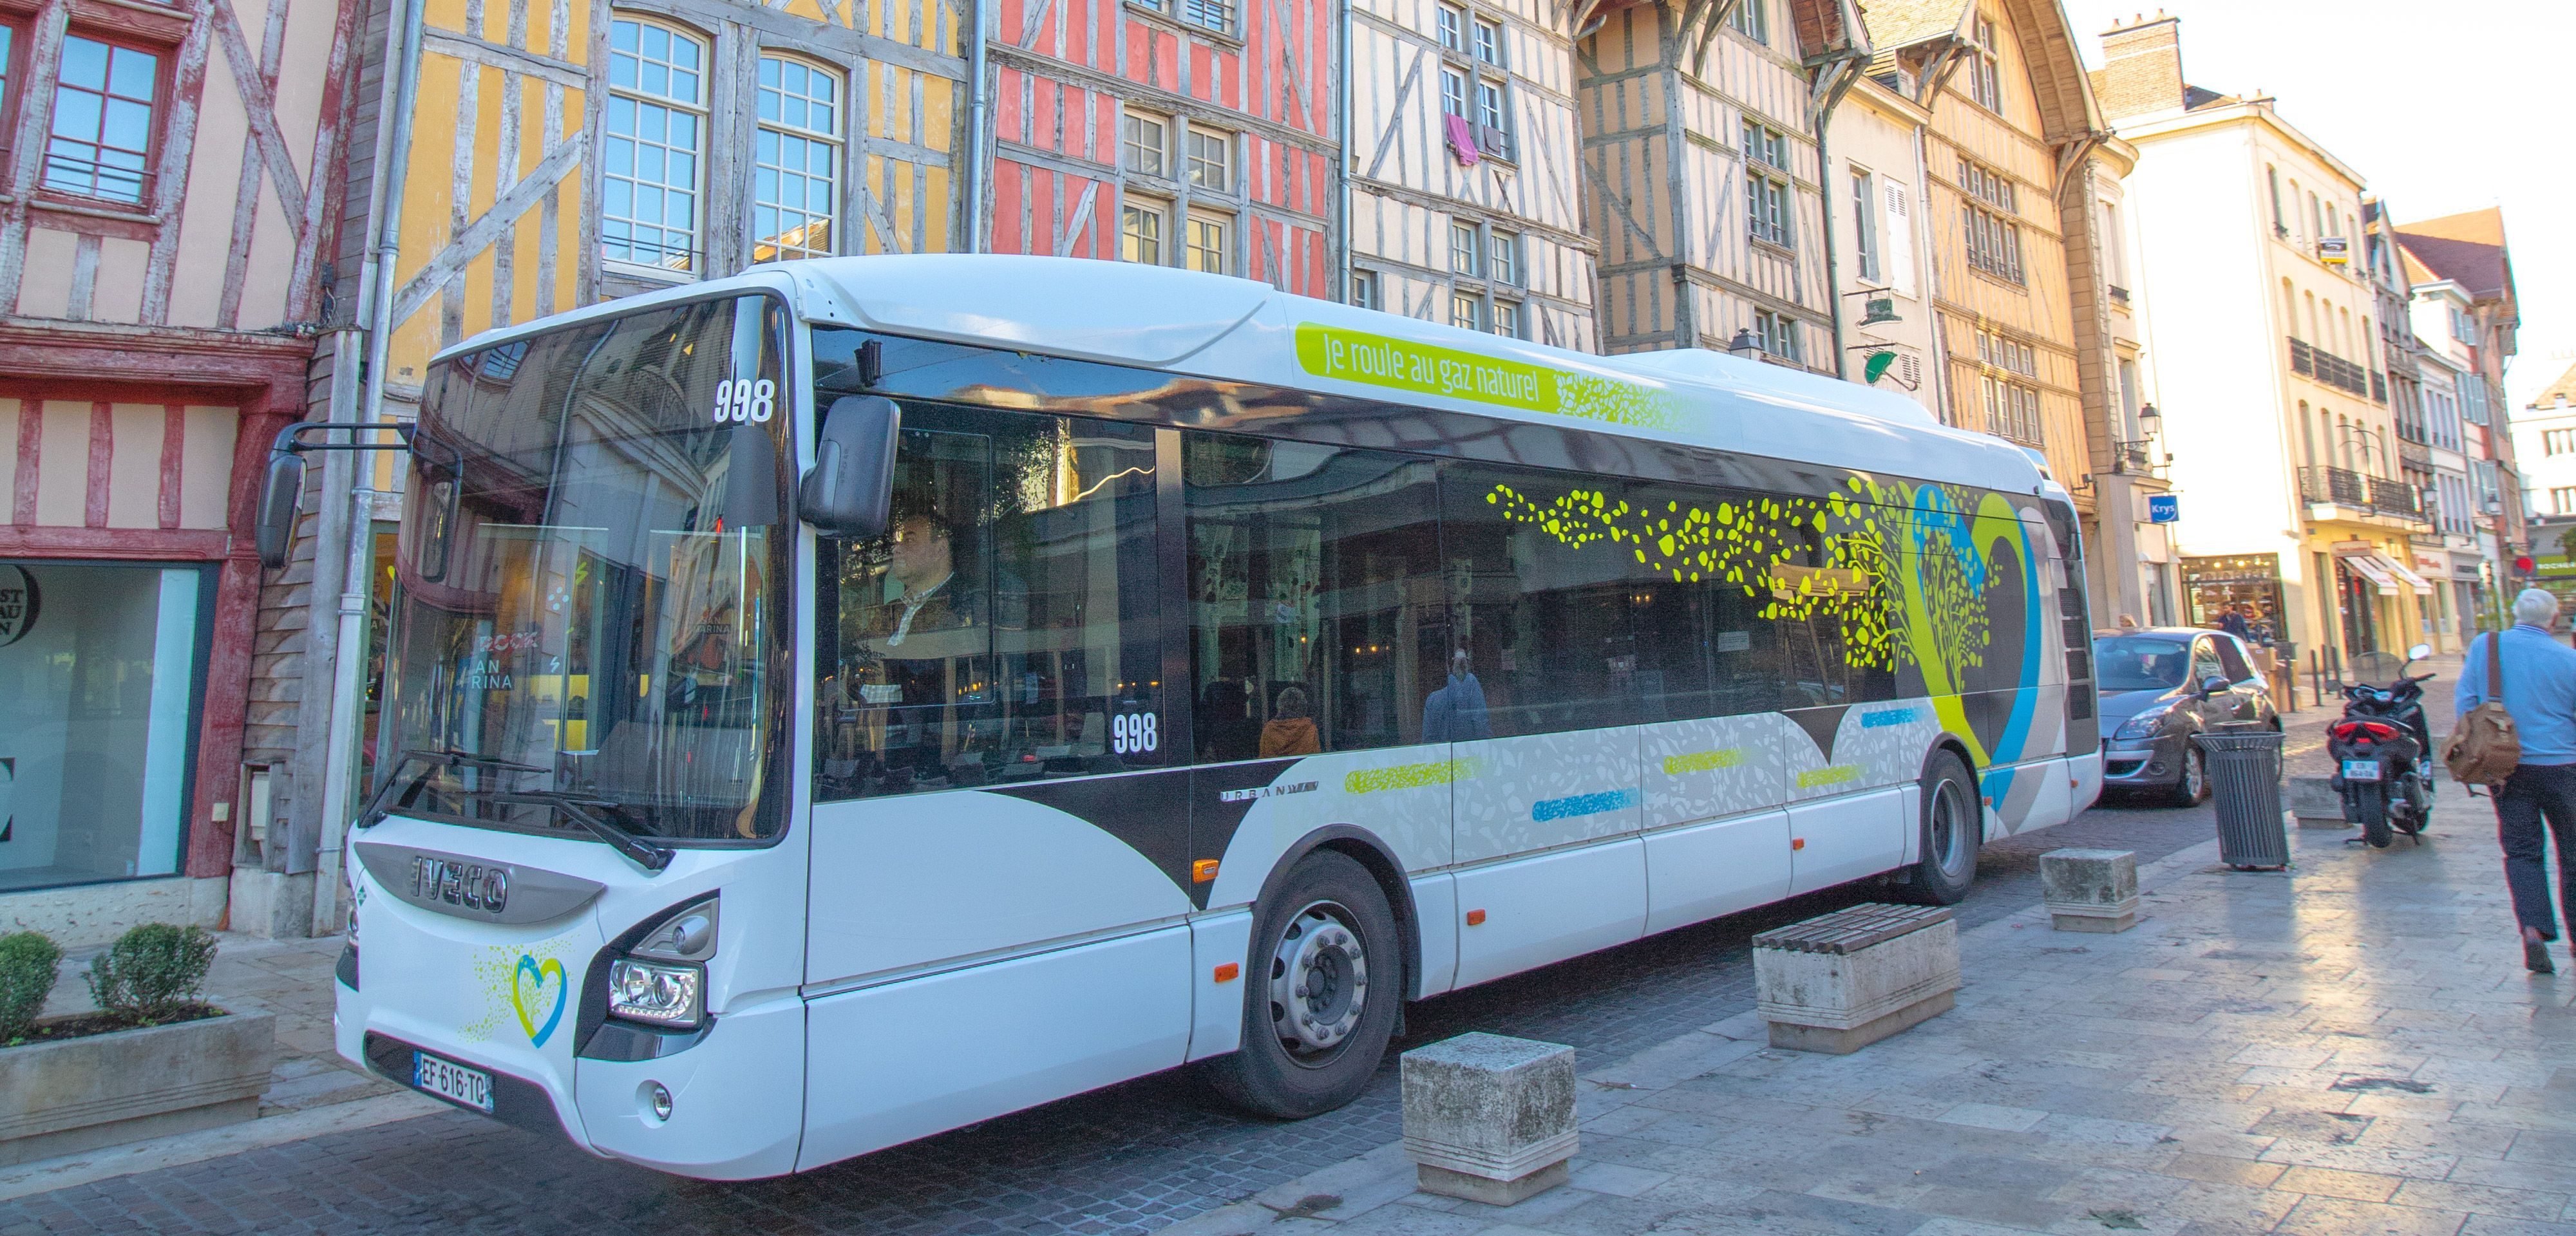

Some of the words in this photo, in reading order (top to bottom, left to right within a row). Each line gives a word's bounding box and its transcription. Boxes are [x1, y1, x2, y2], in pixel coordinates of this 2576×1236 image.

[1324, 333, 1345, 374] Je
[1351, 343, 1405, 379] roule
[1410, 354, 1434, 384] au
[1439, 359, 1472, 393] gaz
[1476, 366, 1539, 402] naturel
[714, 379, 775, 422] 998
[2151, 504, 2175, 515] Krys
[1114, 712, 1157, 754] 998
[411, 856, 507, 913] IVECO
